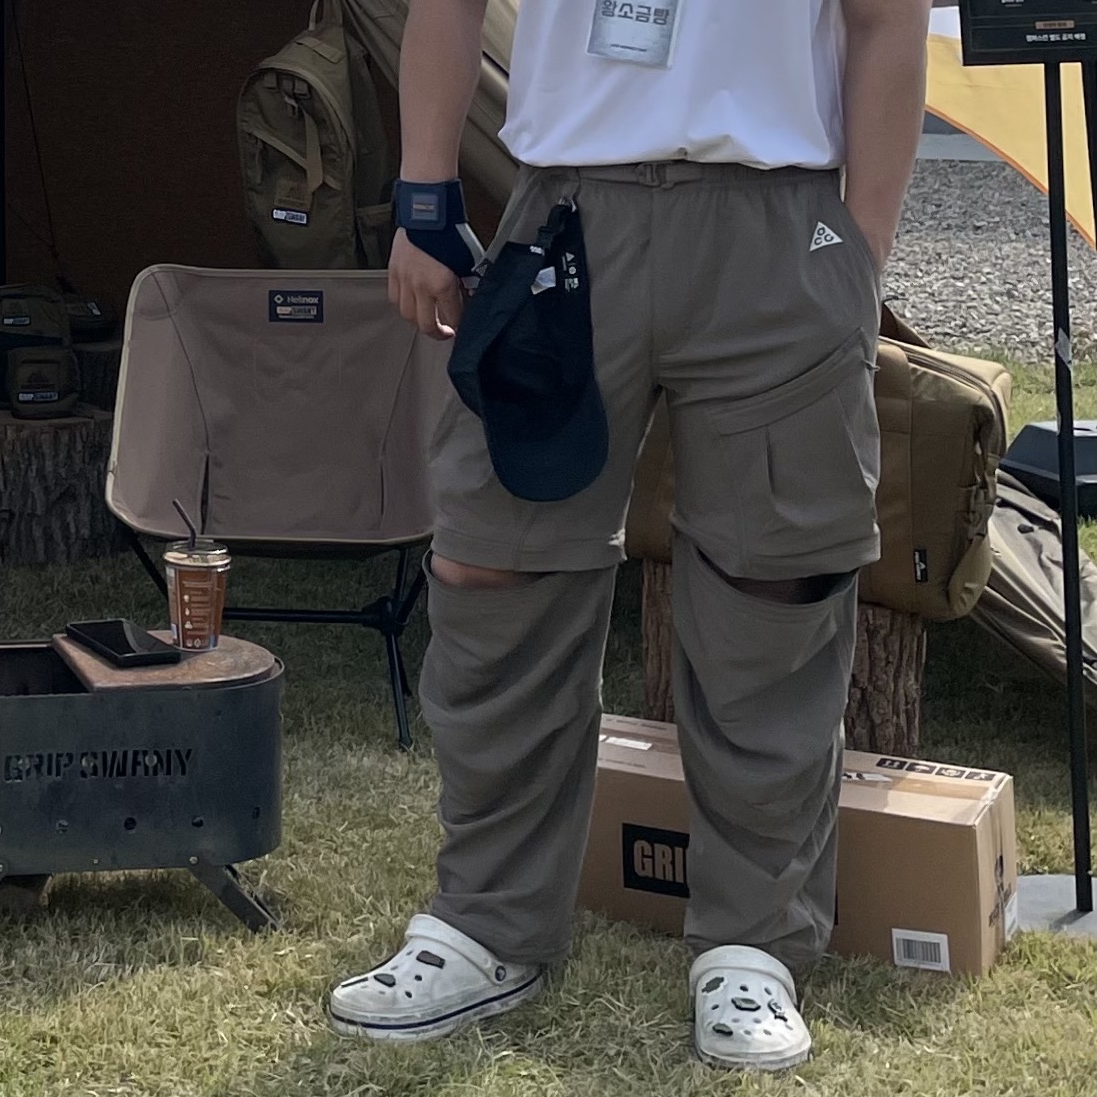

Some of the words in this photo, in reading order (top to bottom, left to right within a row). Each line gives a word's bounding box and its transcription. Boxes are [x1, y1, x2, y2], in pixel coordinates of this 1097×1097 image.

[4, 753, 75, 783] GRIP
[79, 748, 193, 779] SWANY
[633, 839, 685, 884] GRI
